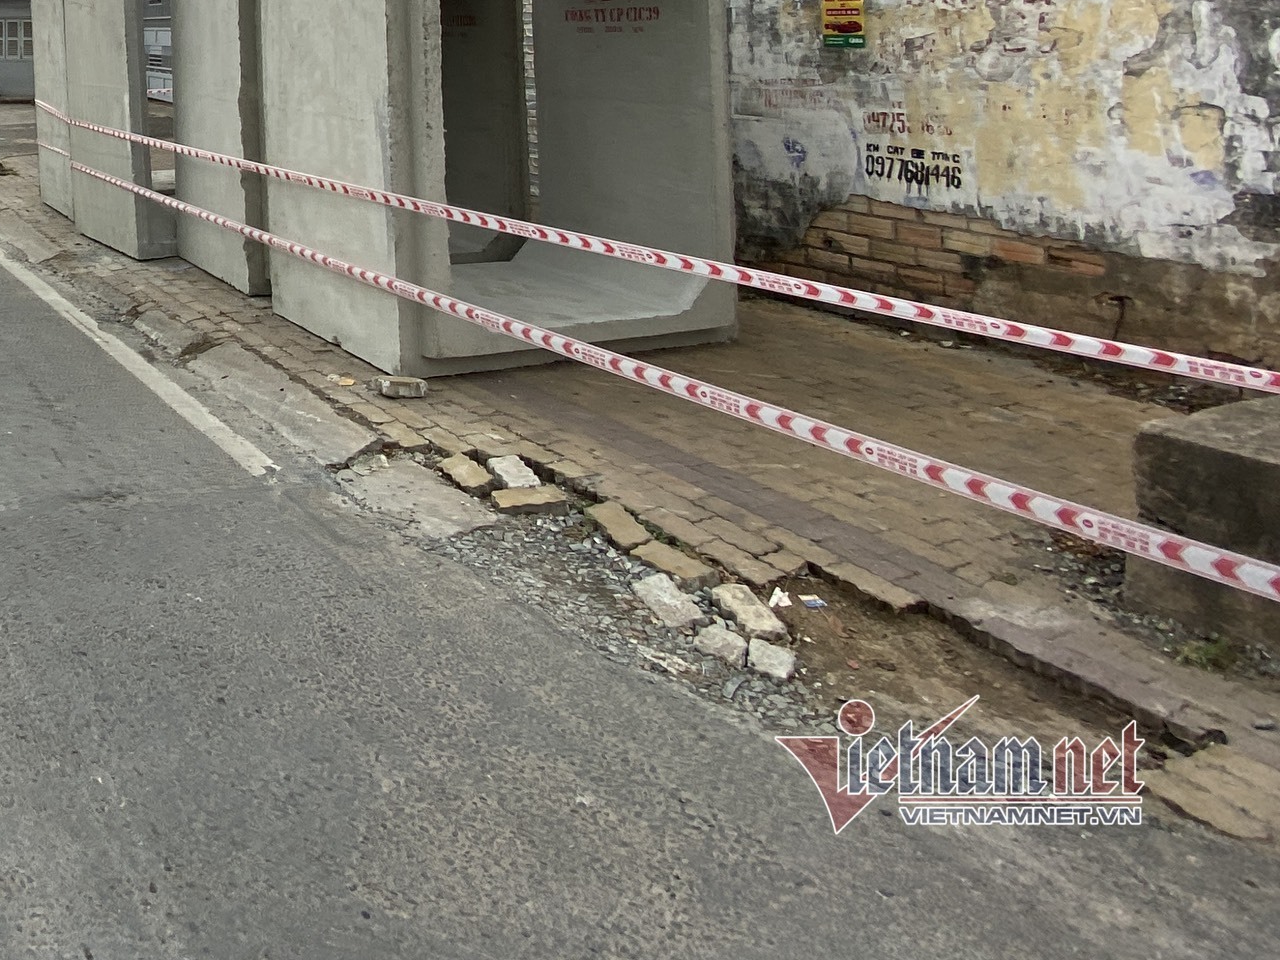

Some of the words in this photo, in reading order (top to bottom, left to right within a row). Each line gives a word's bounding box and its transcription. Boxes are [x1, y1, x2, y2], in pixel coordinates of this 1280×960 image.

[593, 8, 607, 22] TY
[609, 7, 624, 22] CP
[865, 154, 962, 190] 0977681446
